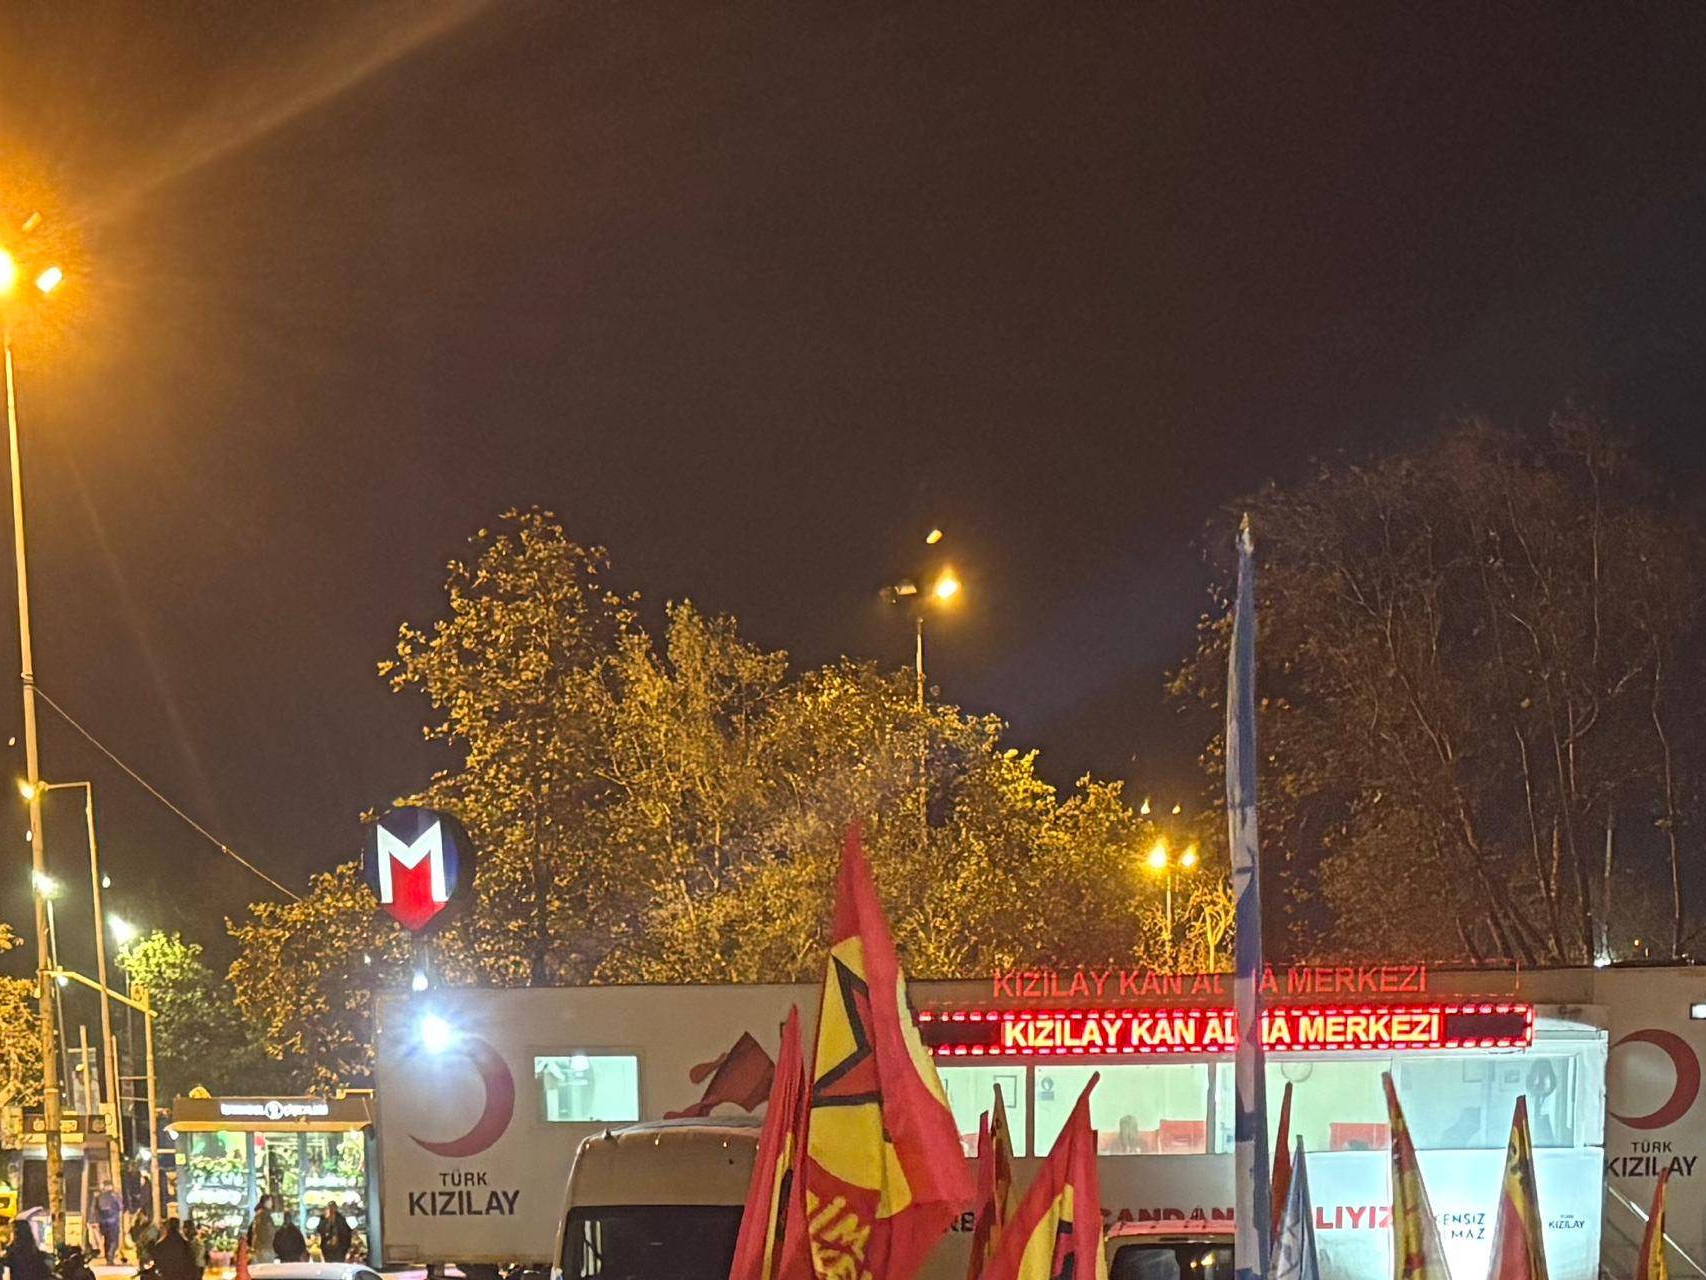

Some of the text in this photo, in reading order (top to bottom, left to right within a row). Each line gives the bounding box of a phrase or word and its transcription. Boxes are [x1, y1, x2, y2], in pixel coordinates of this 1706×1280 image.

[1192, 968, 1277, 995] ALA
[1004, 1018, 1122, 1047] KIZILAY
[1131, 1017, 1195, 1045] KAN
[1632, 1140, 1672, 1153] TÜRK
[439, 1170, 489, 1187] TÜRK
[1607, 1156, 1698, 1178] KIZILAY
[408, 1190, 520, 1217] KIZILAY
